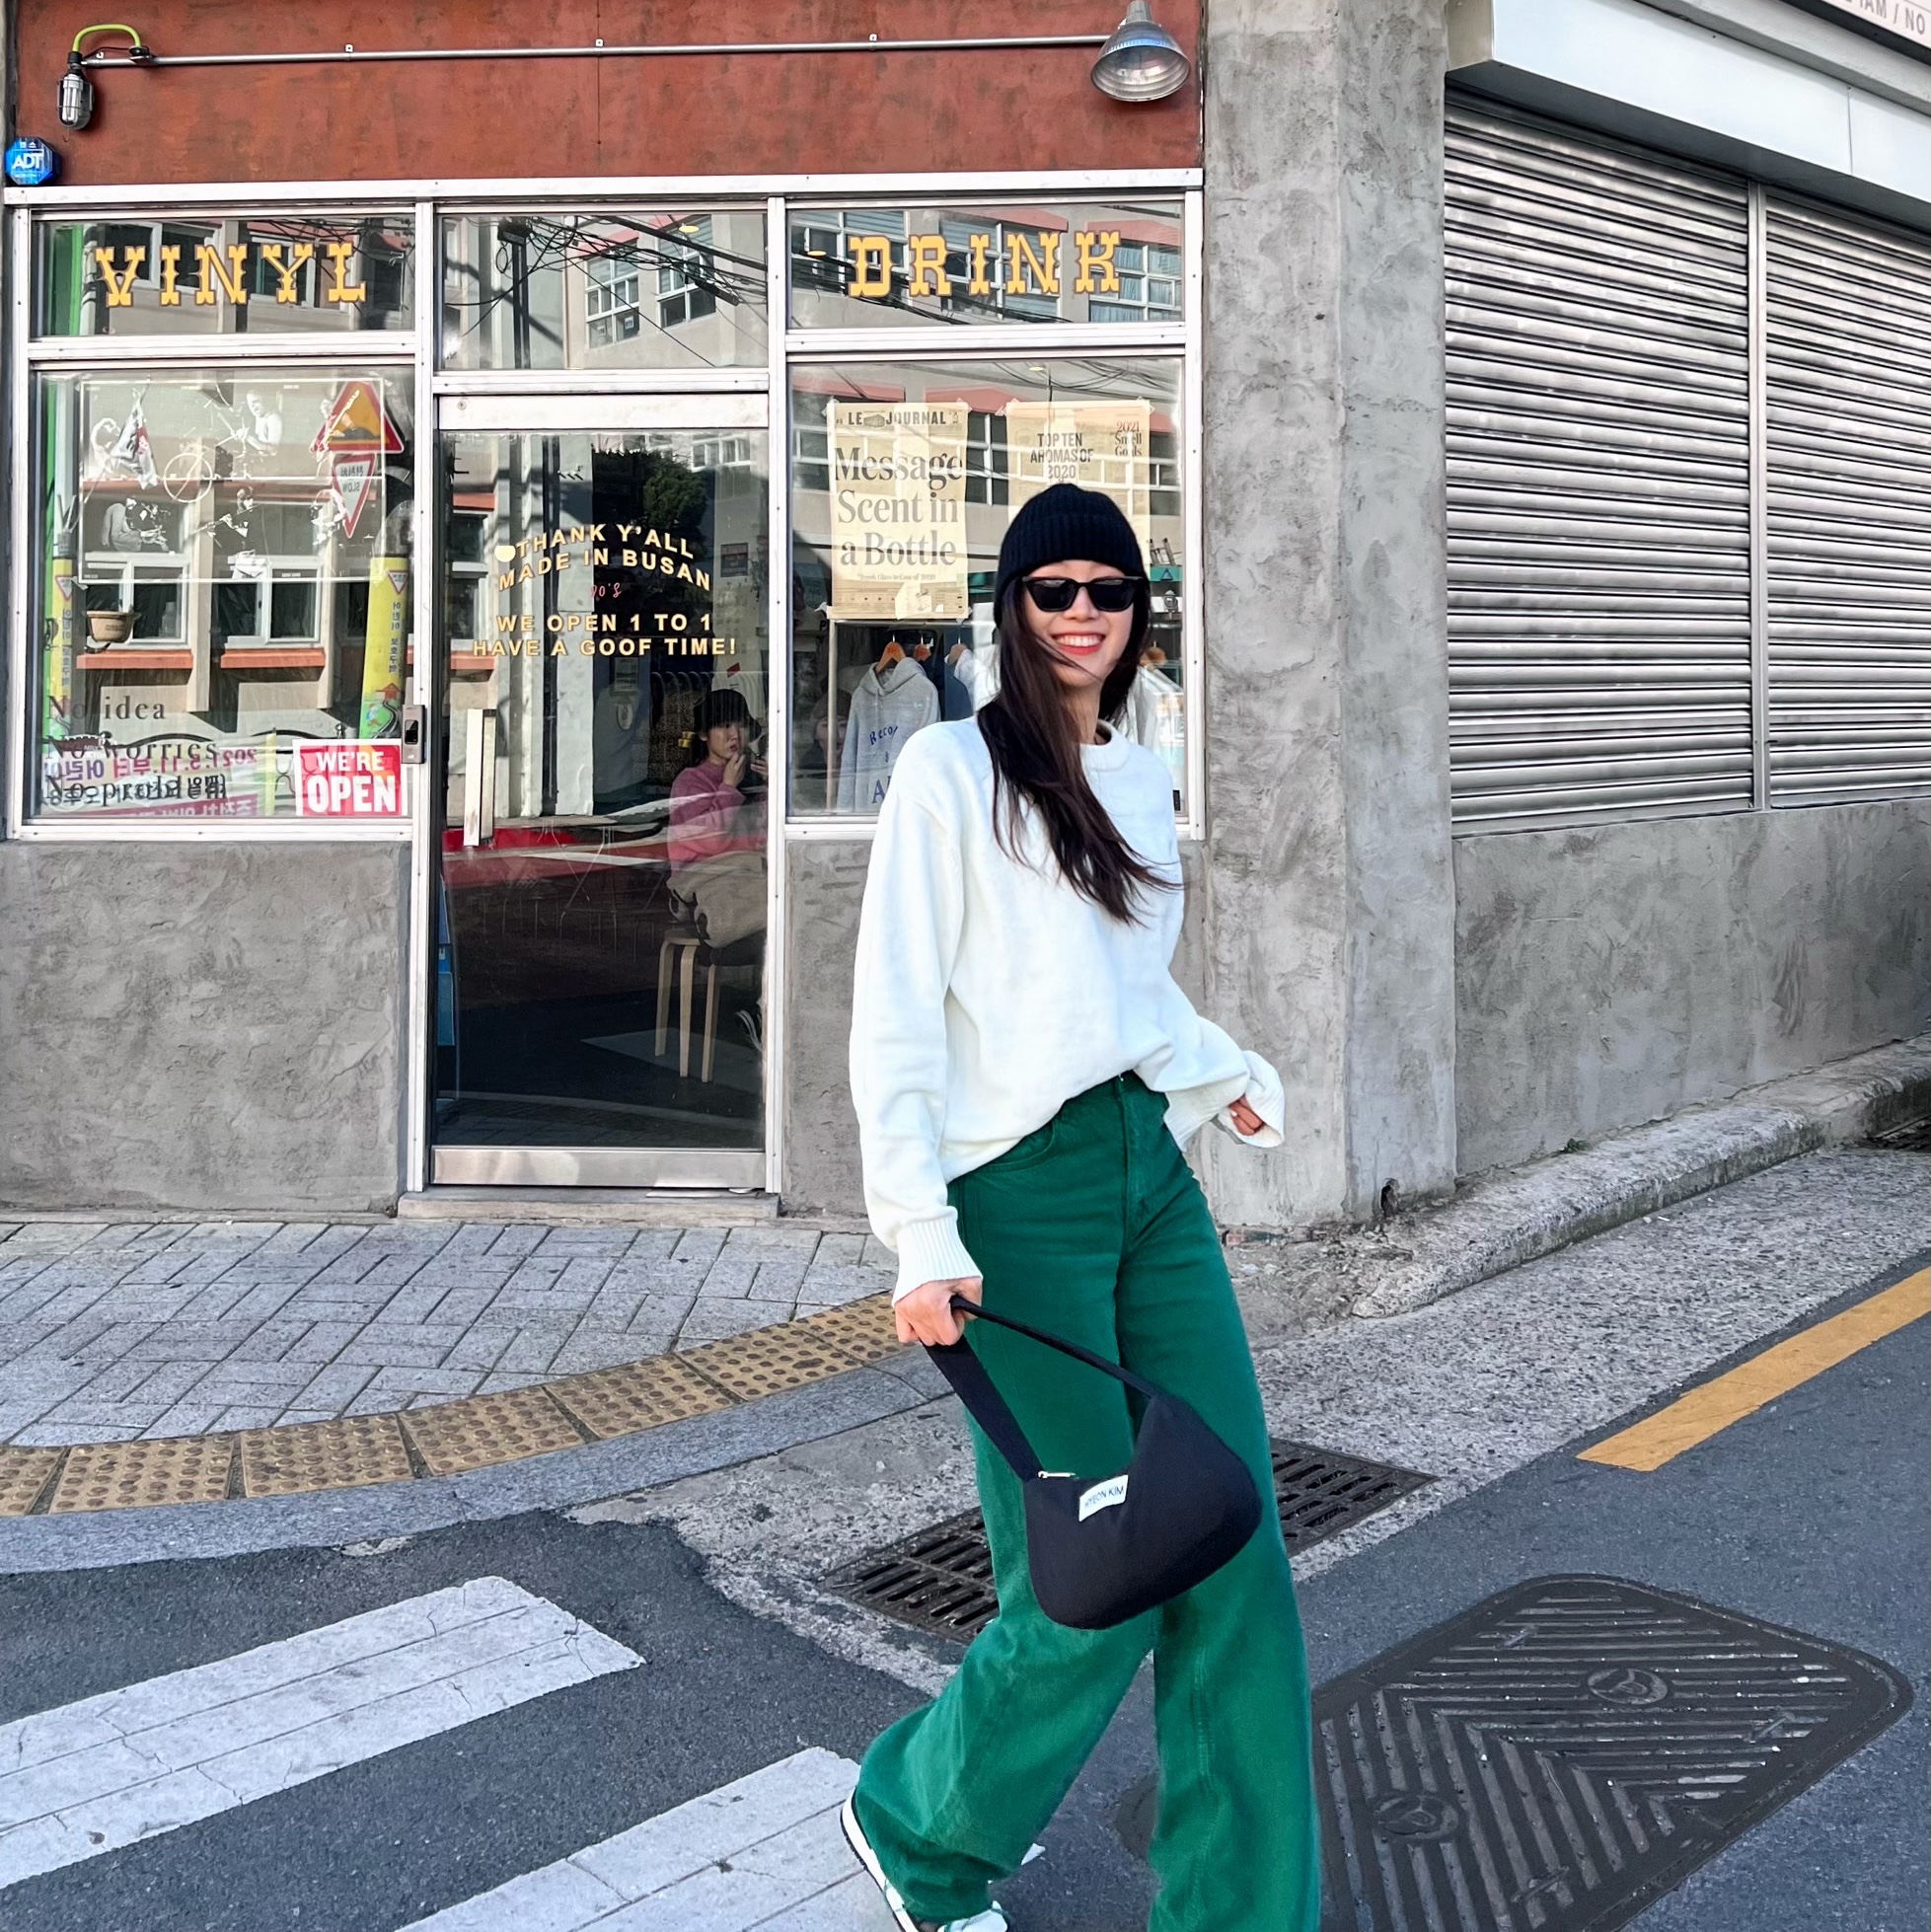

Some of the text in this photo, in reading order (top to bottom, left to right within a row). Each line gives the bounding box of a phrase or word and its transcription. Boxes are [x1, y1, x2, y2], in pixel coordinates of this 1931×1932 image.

[12, 152, 44, 170] ADT
[96, 243, 366, 307] VINYL
[848, 230, 1121, 297] DRINK
[849, 411, 862, 425] LE
[885, 410, 946, 425] JOURNAL
[1116, 420, 1140, 432] 2021
[1061, 432, 1082, 447] TEN
[1079, 448, 1094, 463] OF
[834, 447, 963, 490] Message
[839, 488, 958, 523] Scent in
[516, 523, 695, 560] THANK Y'ALL
[840, 530, 957, 566] a Bottle
[498, 548, 710, 592] MADE IN BUSAN
[496, 613, 711, 632] WE OPEN 1 TO 1
[472, 636, 735, 656] HAVE A GOOF TIME!
[47, 695, 167, 719] No idea
[316, 751, 385, 773] WE'RE
[307, 775, 397, 813] OPEN
[1108, 1485, 1125, 1497] KIM
